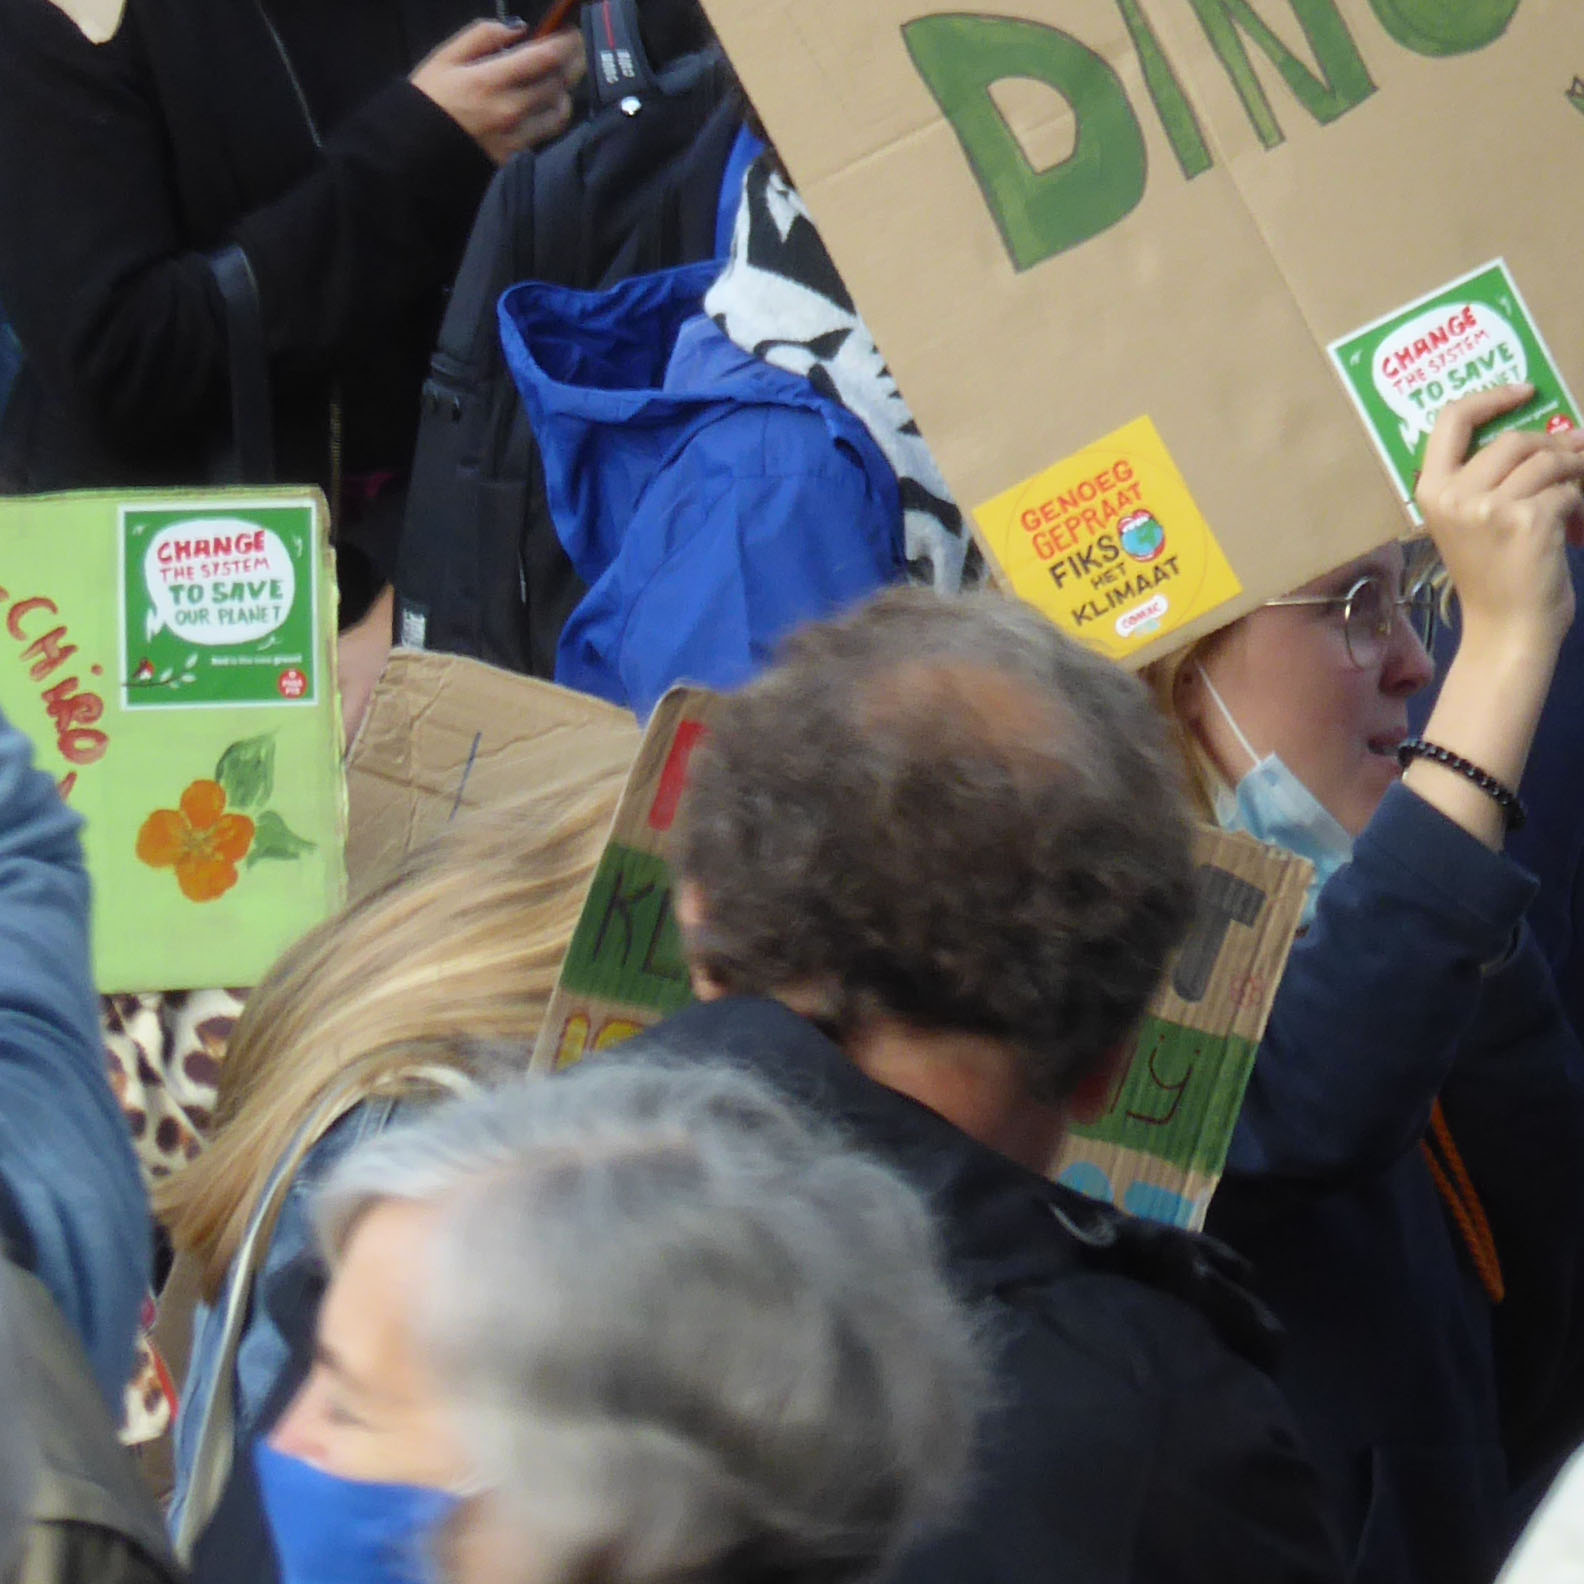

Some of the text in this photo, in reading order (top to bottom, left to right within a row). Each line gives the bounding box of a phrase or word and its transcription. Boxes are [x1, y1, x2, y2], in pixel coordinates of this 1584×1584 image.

[1381, 305, 1478, 380] CHANGE
[1393, 328, 1491, 397] THE SYSTEM
[1407, 341, 1516, 410] TO SAVE
[1019, 458, 1135, 534] GENOEG
[1031, 481, 1144, 562] GEPRAAT
[156, 529, 266, 566] CHANGE
[159, 557, 270, 584] THE SYSTEM
[1048, 533, 1120, 590] FIKS
[1089, 561, 1126, 591] HET
[168, 578, 285, 606] TO SAVE
[173, 605, 282, 627] OUR PLANET
[1071, 556, 1182, 627] KLIMAAT
